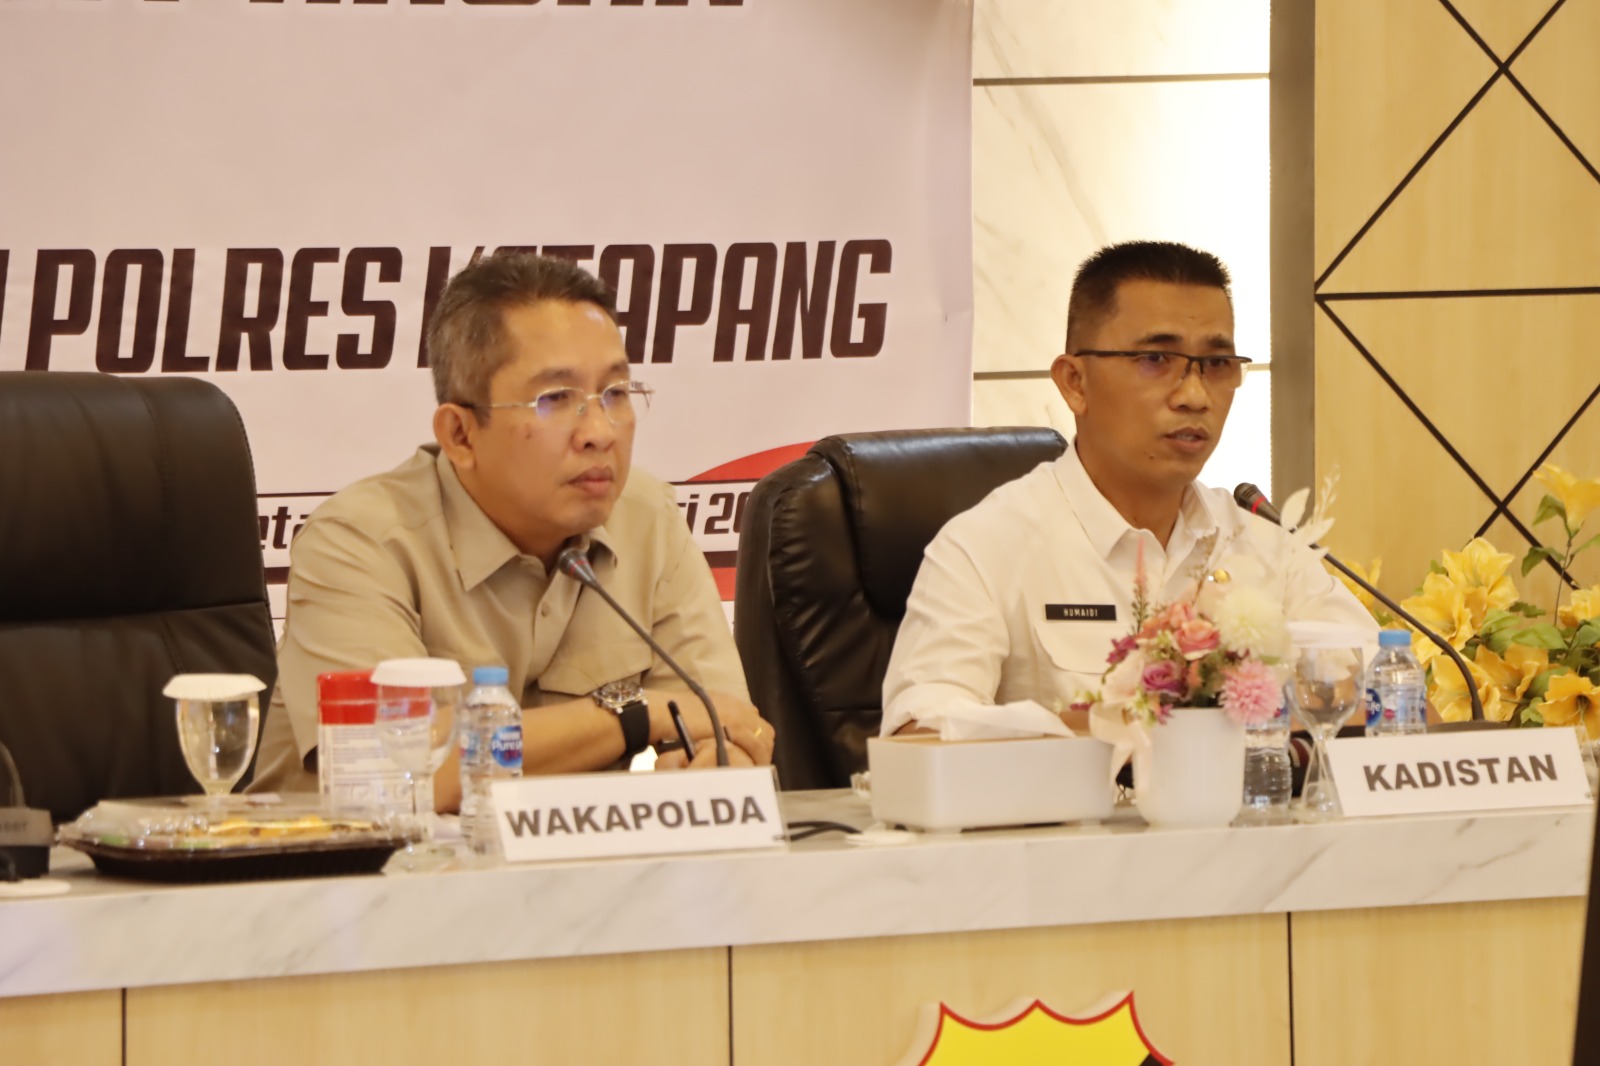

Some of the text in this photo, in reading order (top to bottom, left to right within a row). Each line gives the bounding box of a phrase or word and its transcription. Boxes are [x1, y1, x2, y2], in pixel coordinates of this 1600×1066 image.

[25, 246, 402, 373] POLRES
[1063, 608, 1098, 617] HUMAIDI
[1363, 754, 1558, 792] KADISTAN
[505, 796, 766, 838] WAKAPOLDA
